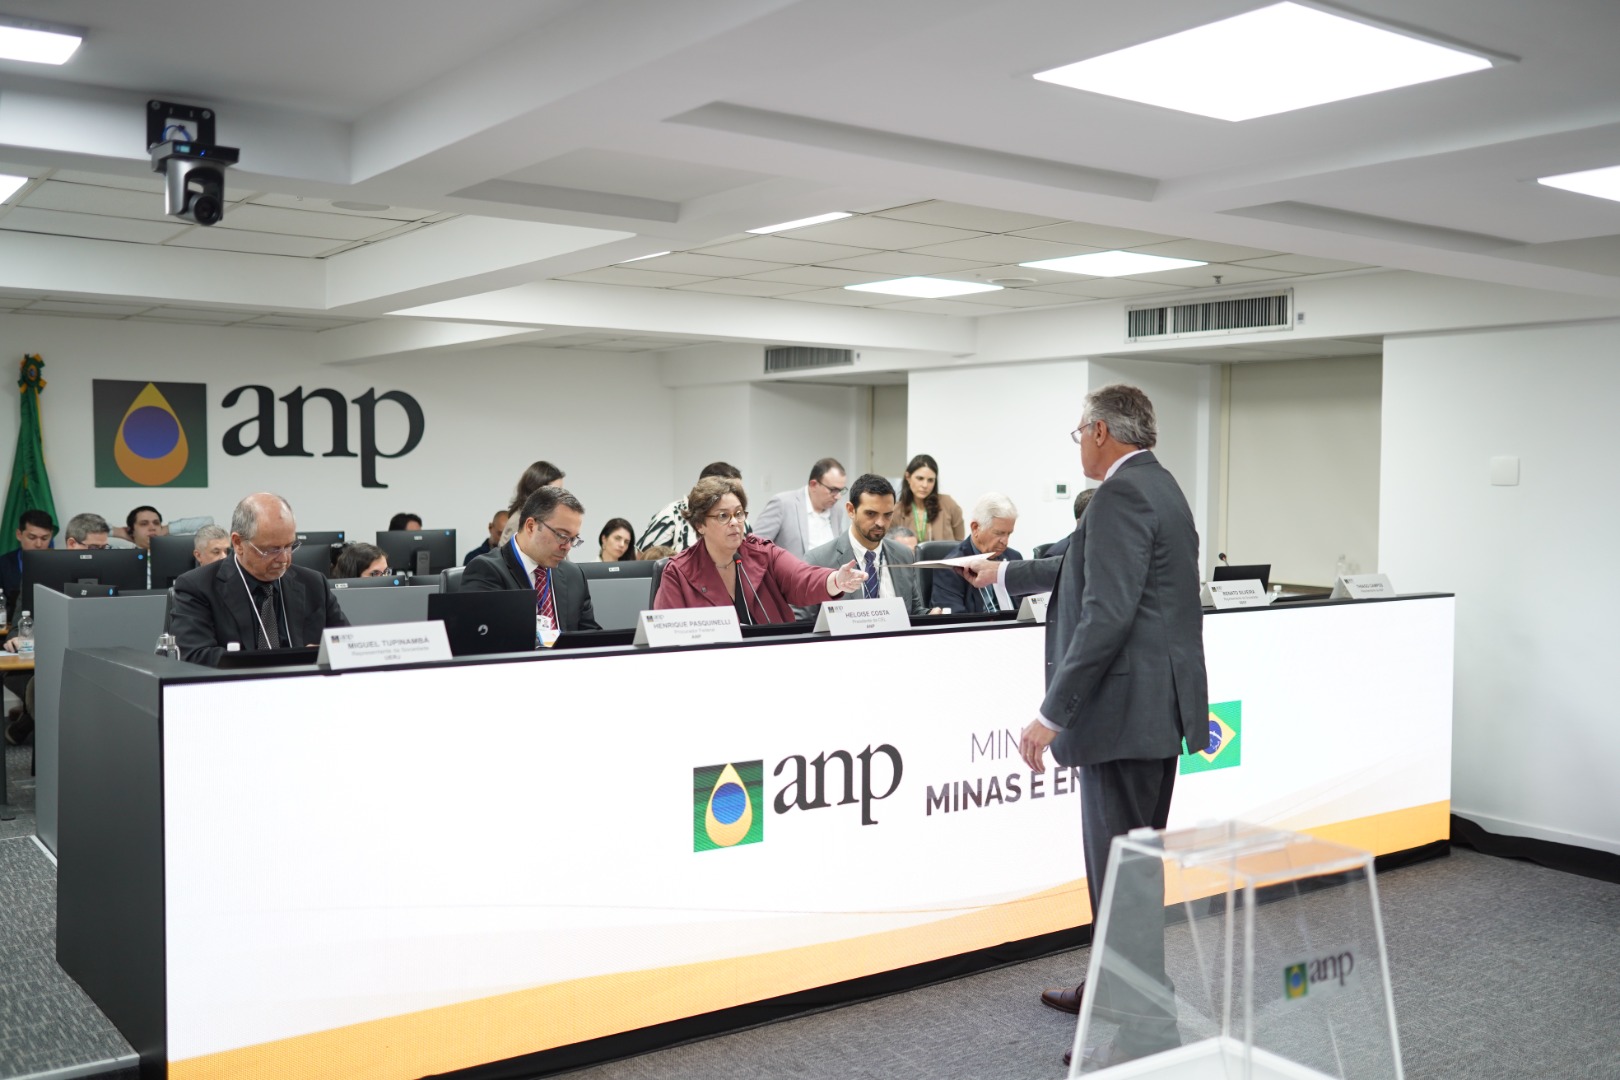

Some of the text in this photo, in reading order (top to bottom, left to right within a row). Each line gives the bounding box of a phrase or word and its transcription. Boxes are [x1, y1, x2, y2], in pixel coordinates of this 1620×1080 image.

[221, 385, 425, 488] anp
[653, 619, 731, 629] HENRIQUE PASQUINELLI
[348, 641, 379, 650] MIGUEL
[971, 727, 1049, 763] MIN
[773, 743, 903, 826] anp
[926, 773, 1022, 816] MINAS
[1030, 770, 1045, 799] E
[1309, 951, 1355, 987] anp
